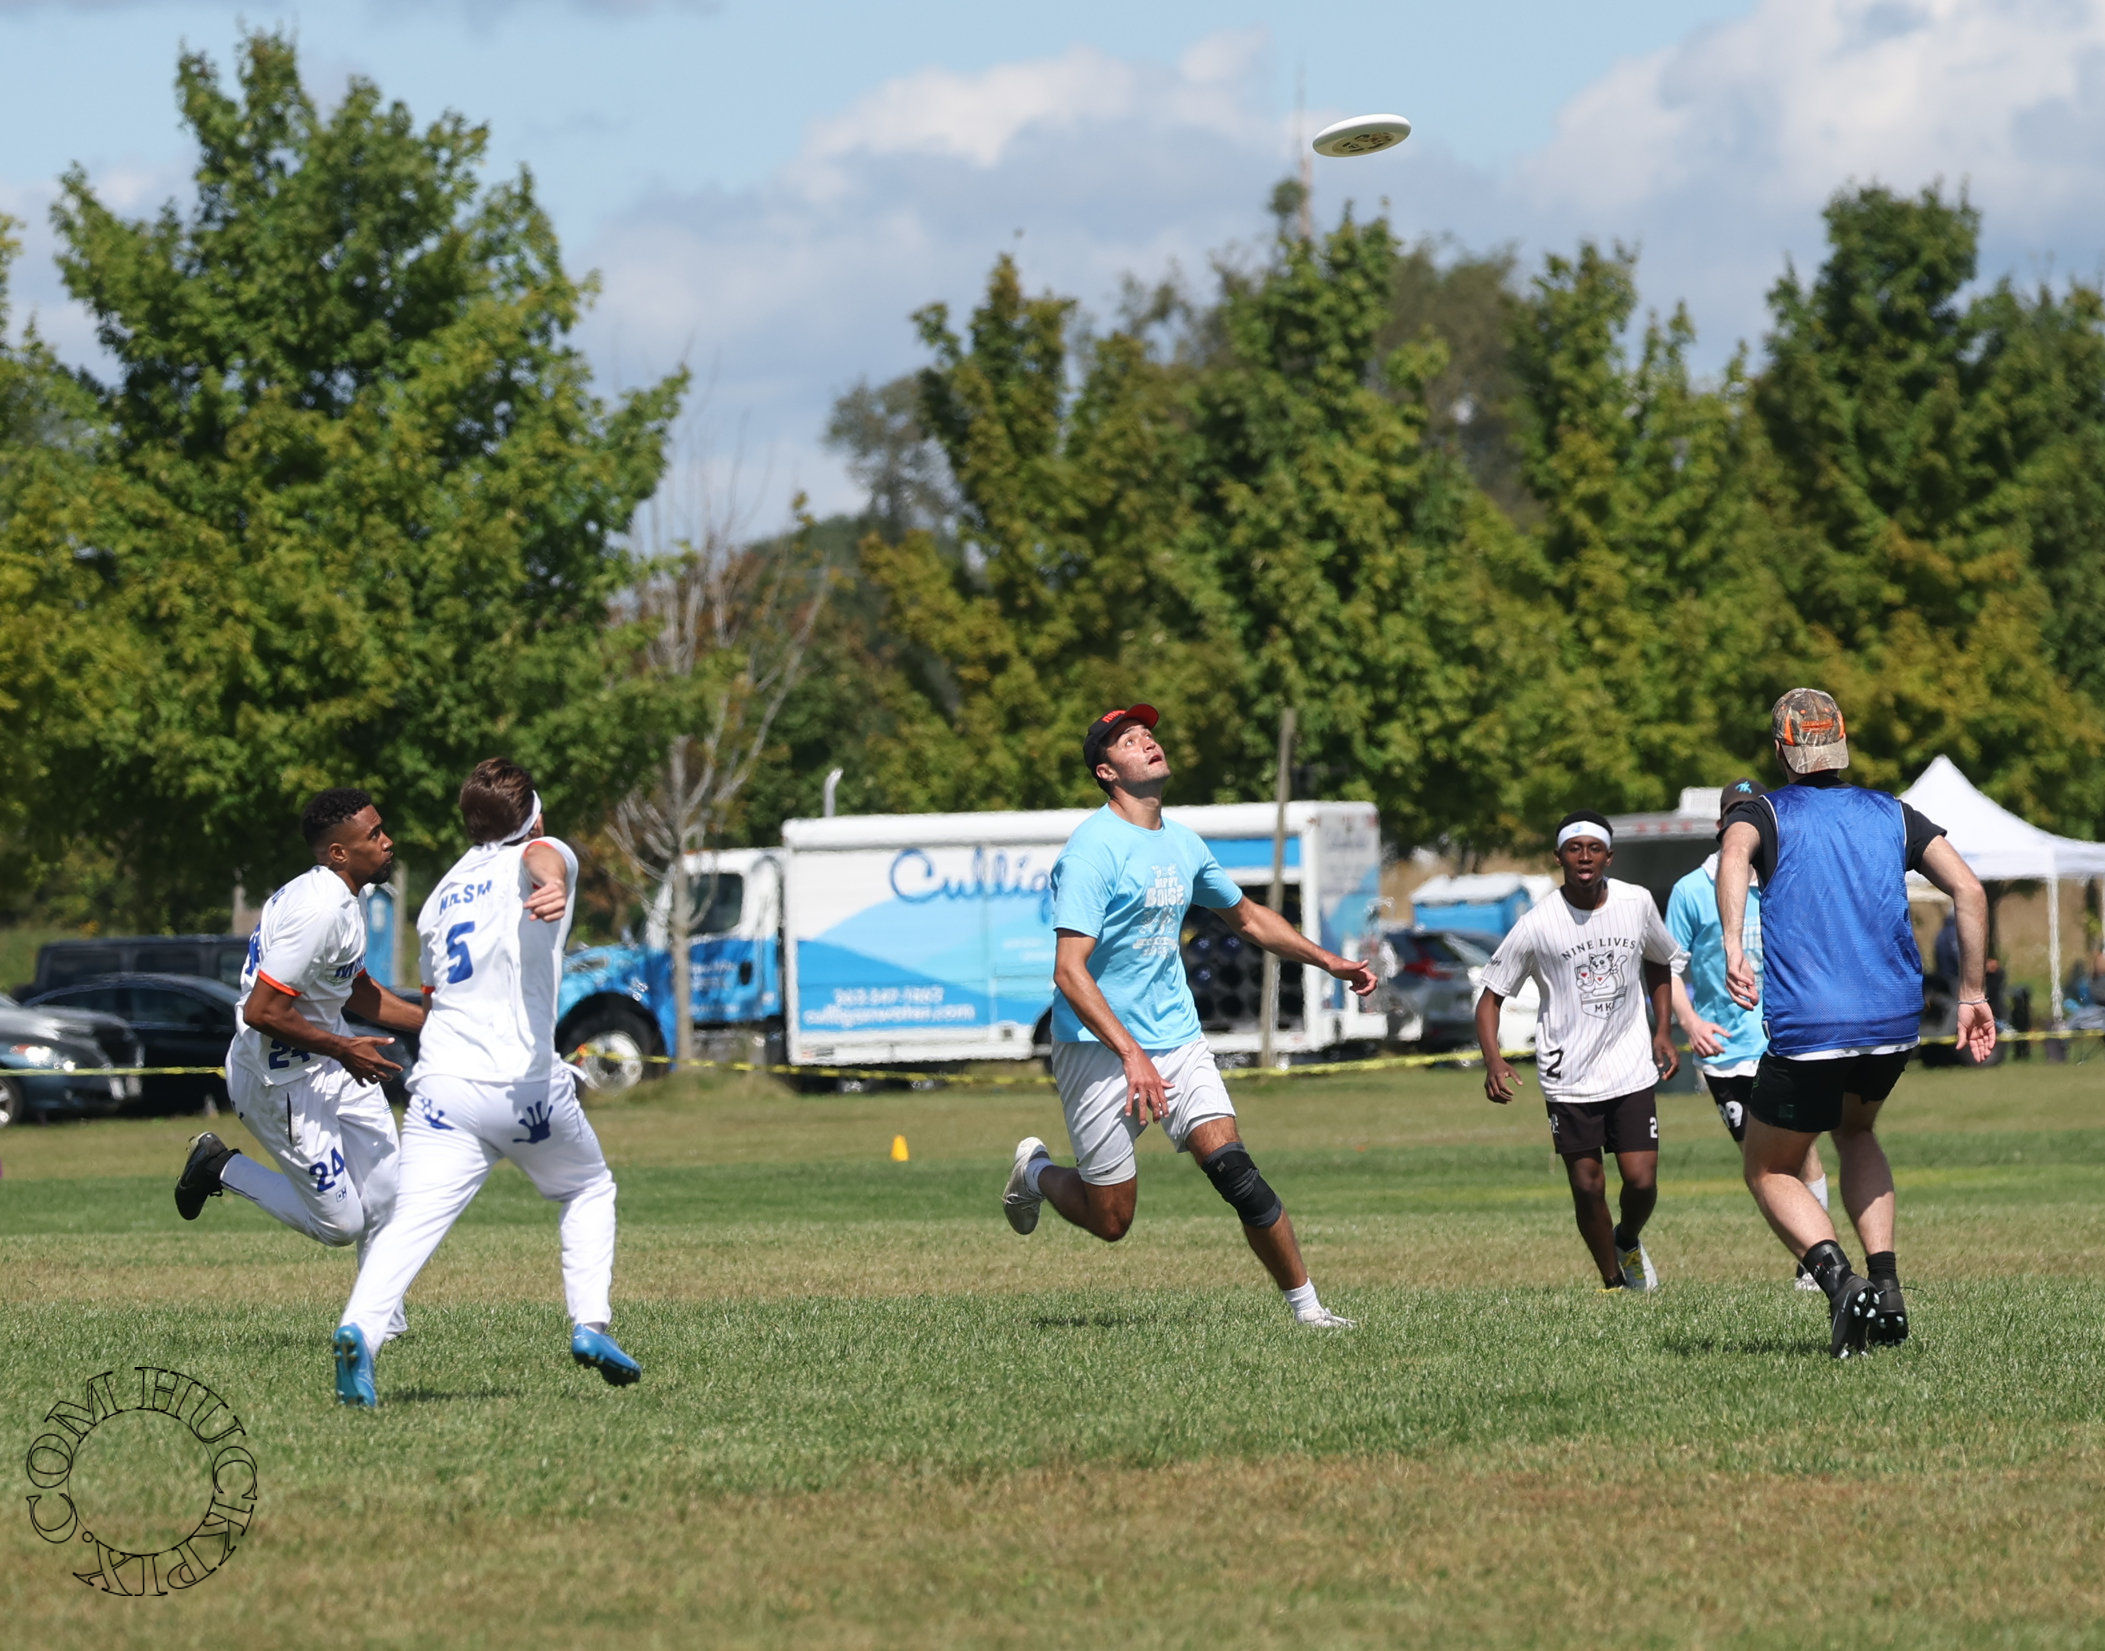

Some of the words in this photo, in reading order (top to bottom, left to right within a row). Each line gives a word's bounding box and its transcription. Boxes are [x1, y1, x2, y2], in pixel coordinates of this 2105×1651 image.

[888, 846, 1053, 925] Cullig
[446, 920, 475, 984] 5
[1561, 939, 1595, 961] NINE
[1599, 937, 1636, 950] LIVES
[1546, 1048, 1564, 1079] 2
[1649, 1116, 1659, 1139] 2
[308, 1146, 345, 1193] 24
